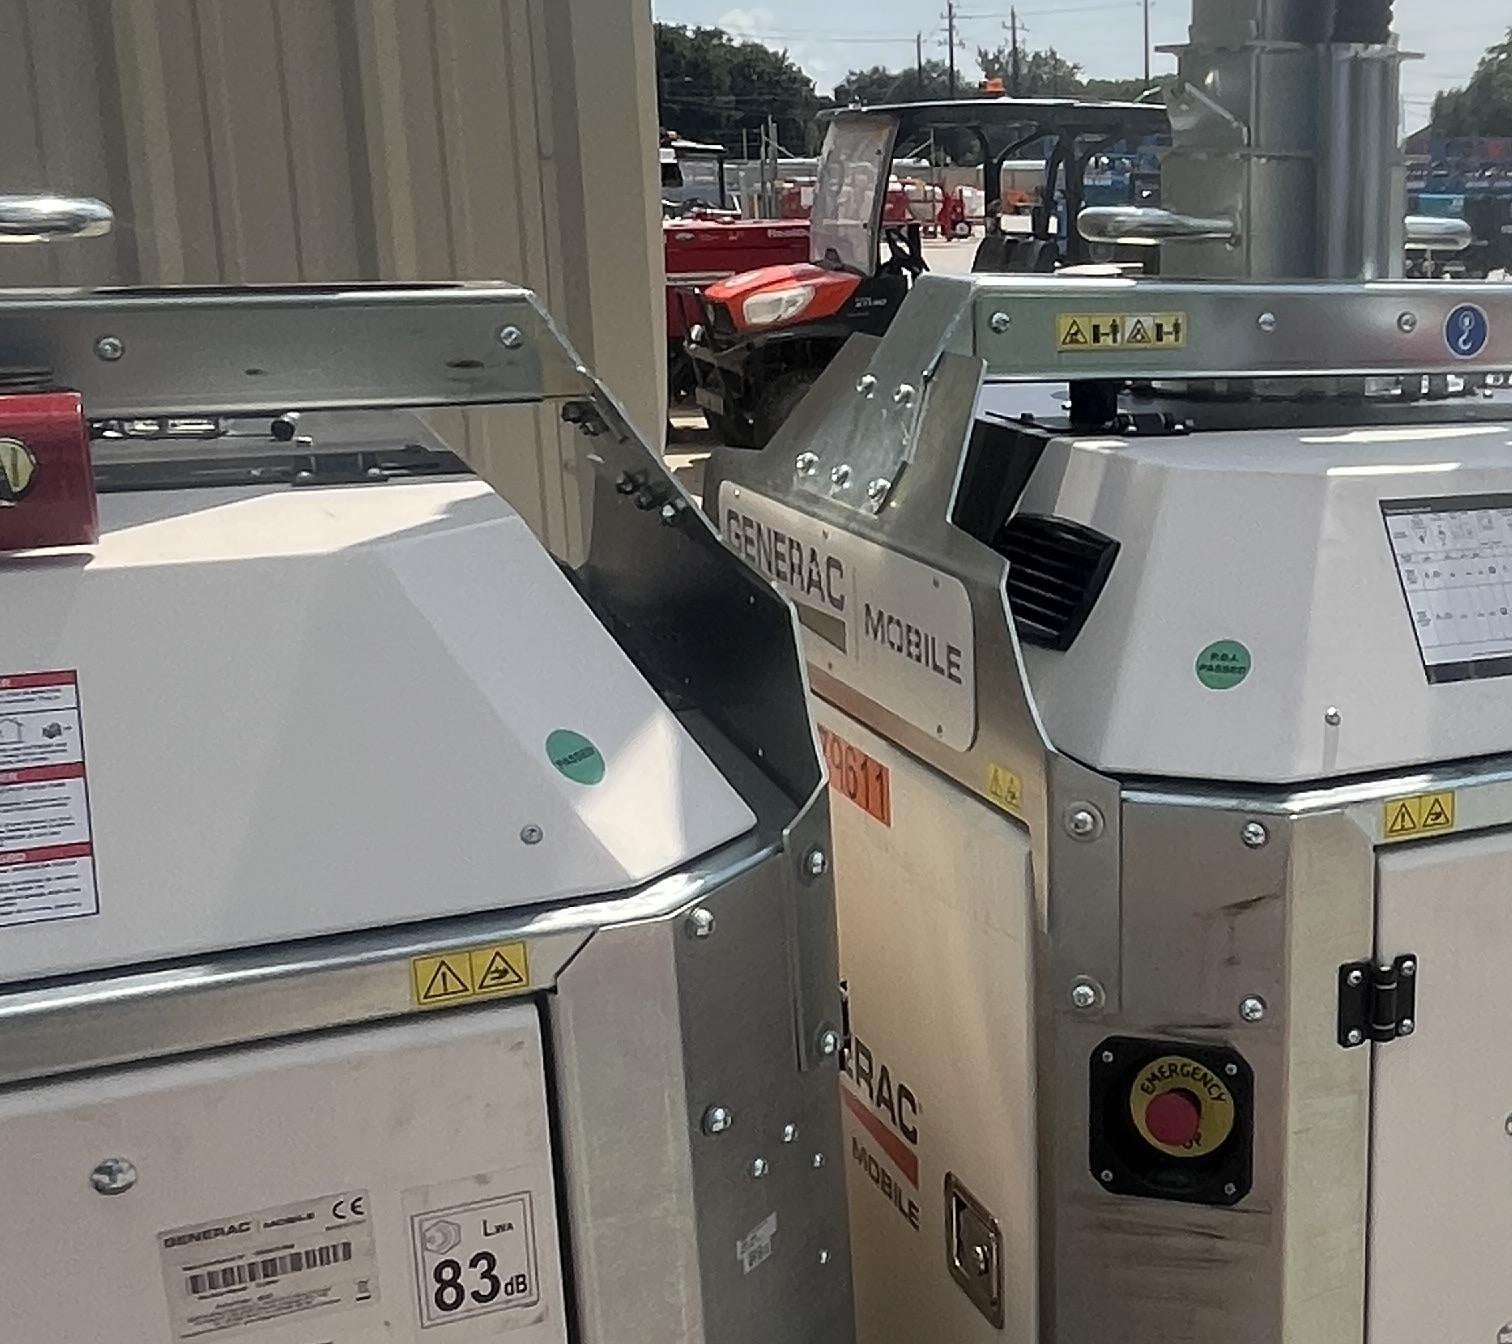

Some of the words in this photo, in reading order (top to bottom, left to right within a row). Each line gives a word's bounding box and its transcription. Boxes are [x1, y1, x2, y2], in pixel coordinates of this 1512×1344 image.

[726, 509, 845, 611] GENERAC
[863, 603, 962, 684] MOBILE
[1140, 1062, 1227, 1103] EMERGENCY
[852, 1137, 921, 1232] MOBILE
[432, 1250, 502, 1313] 83
[503, 1274, 529, 1297] dB
